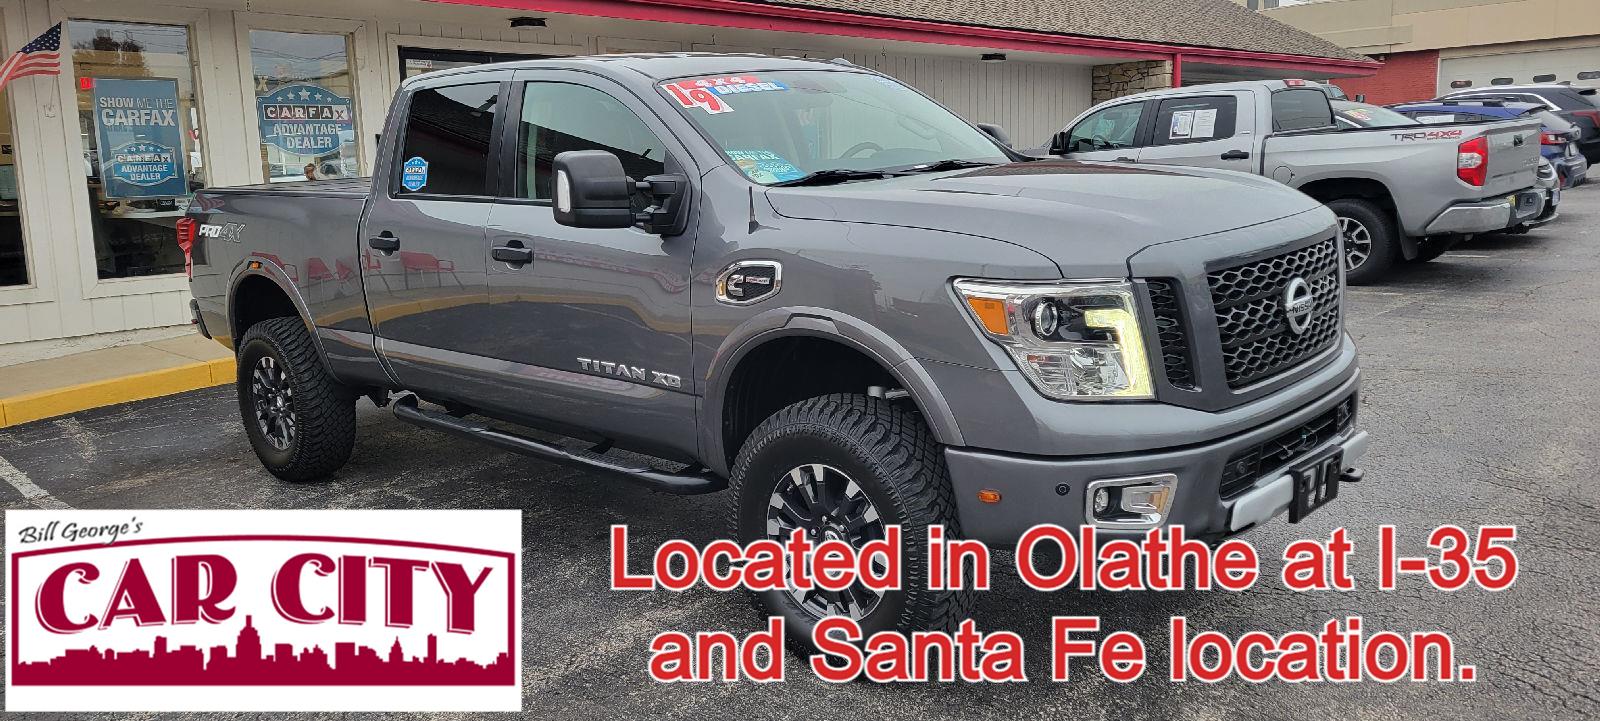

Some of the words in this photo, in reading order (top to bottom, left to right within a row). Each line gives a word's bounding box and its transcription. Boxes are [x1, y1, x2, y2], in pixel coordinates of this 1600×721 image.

[716, 81, 784, 96] DIESEL
[99, 97, 134, 108] SHOW
[136, 98, 153, 108] ME
[155, 98, 173, 109] THE
[665, 84, 721, 112] 19
[101, 109, 176, 127] CARFAX
[264, 105, 347, 120] CARFAX
[273, 124, 342, 135] ADVANTAGE
[286, 136, 333, 149] DEALER
[116, 154, 171, 163] CARFAX
[121, 163, 169, 173] ADVANTAGE
[130, 172, 161, 181] DEALER
[577, 357, 646, 381] TITAN
[651, 370, 681, 388] XD
